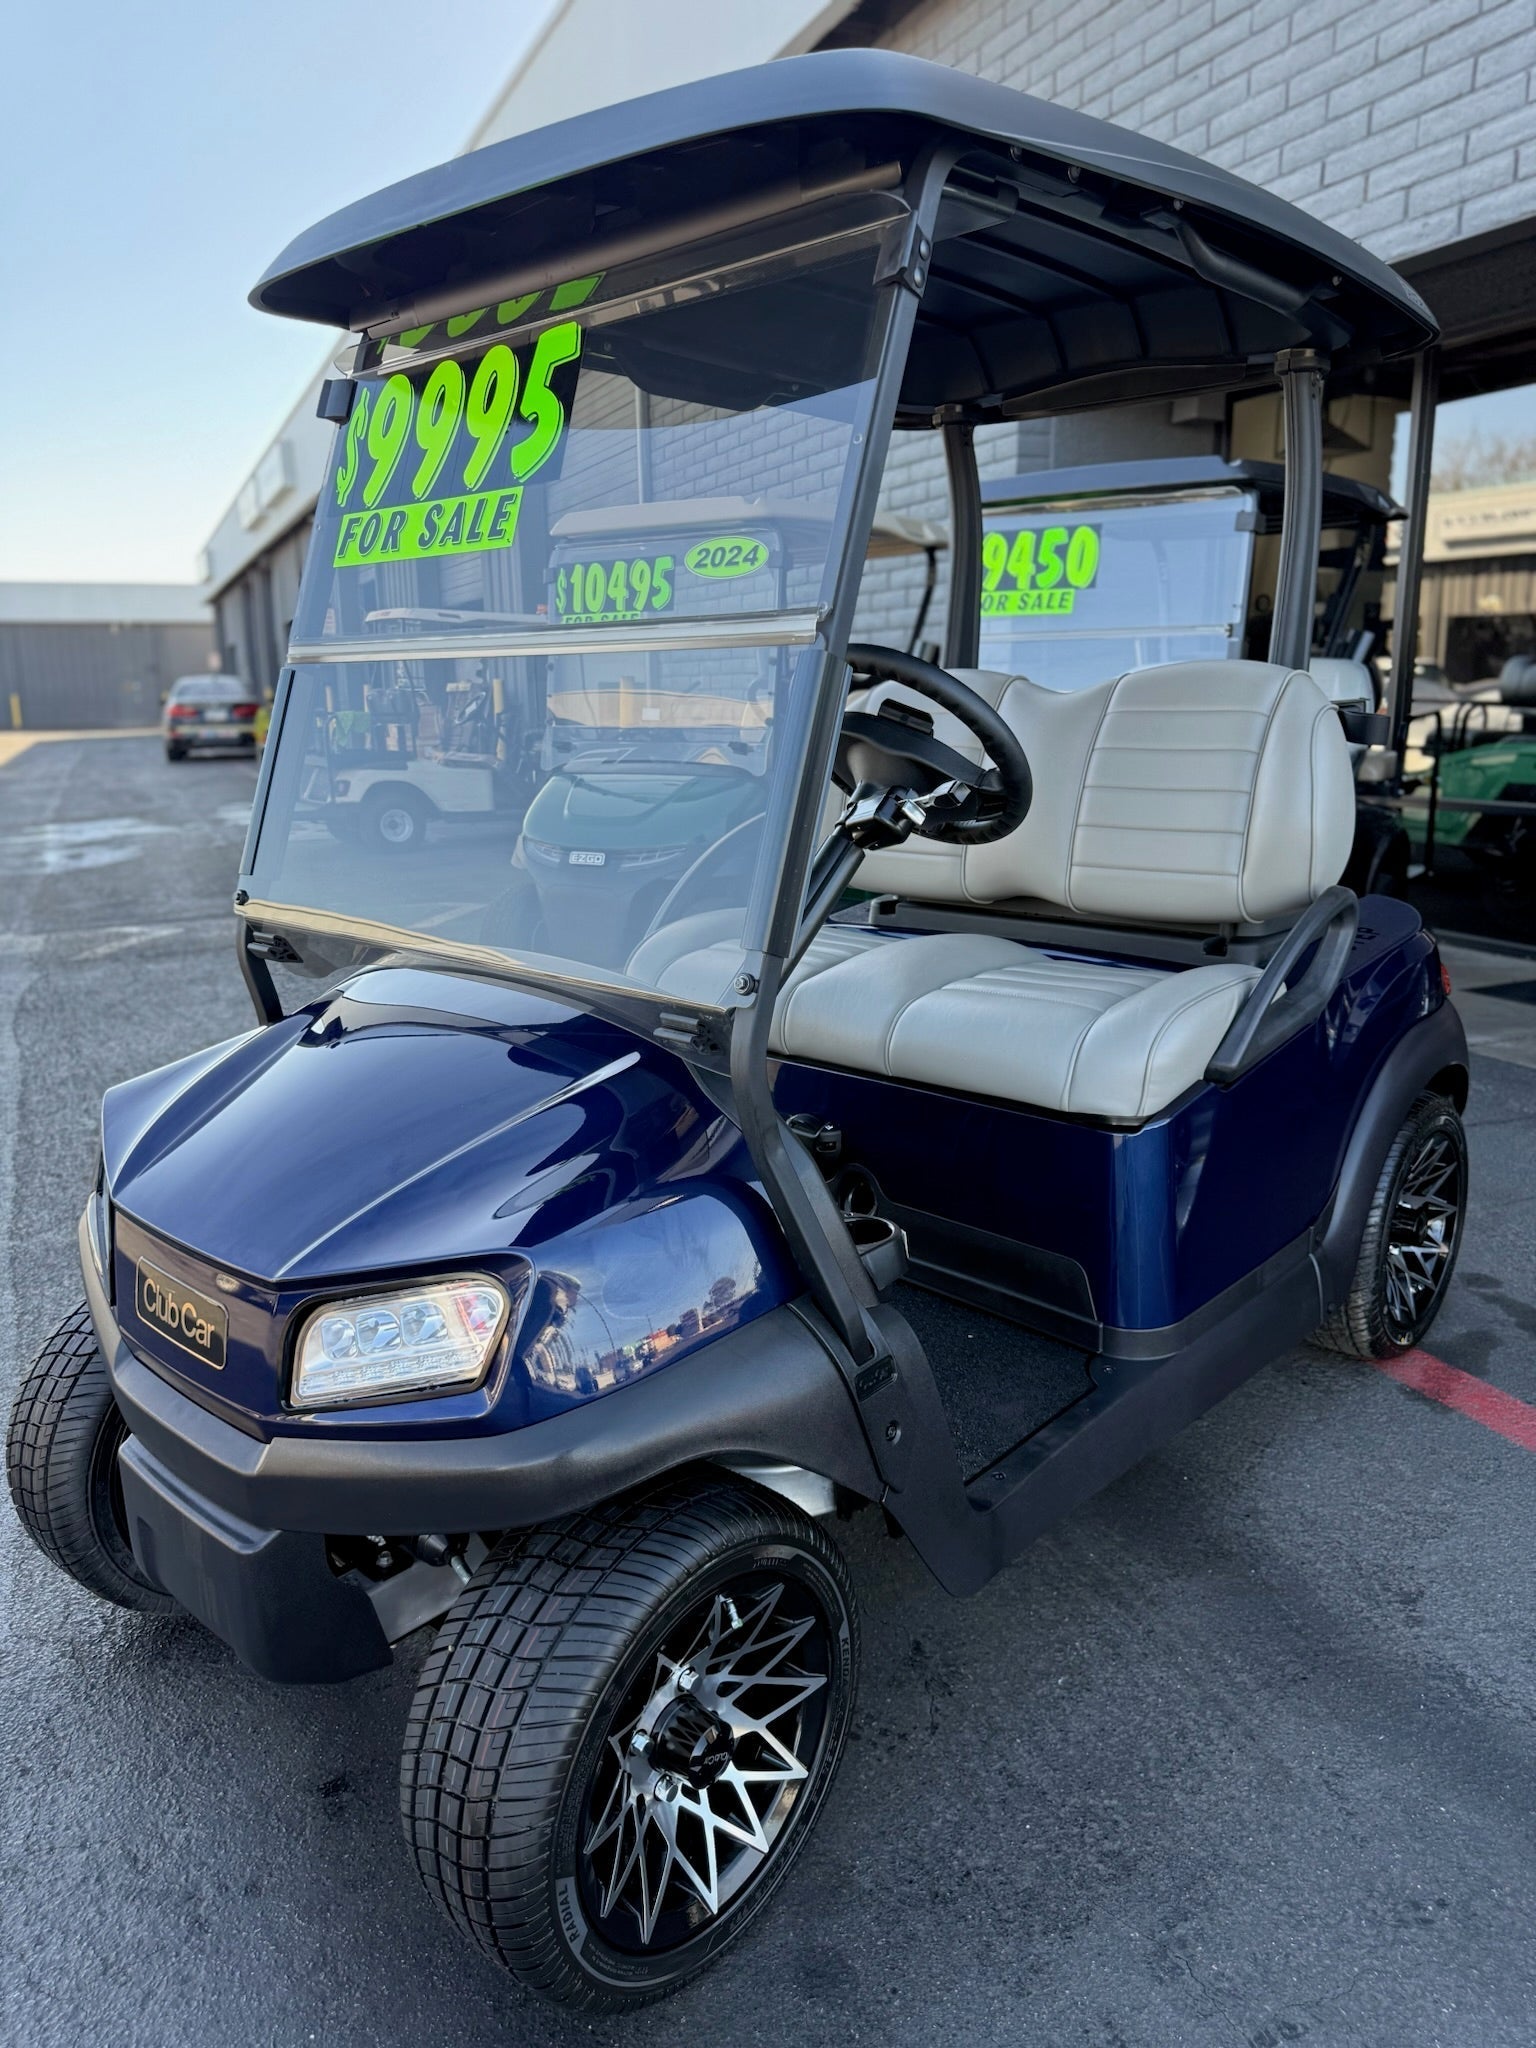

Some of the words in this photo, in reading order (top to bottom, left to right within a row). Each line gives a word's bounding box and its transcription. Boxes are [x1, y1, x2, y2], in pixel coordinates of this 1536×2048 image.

[336, 320, 581, 509] $9995
[337, 510, 408, 558] FOR
[418, 493, 517, 549] SALE
[556, 556, 674, 614] $10495
[693, 545, 760, 568] 2024
[982, 525, 1099, 591] 9450
[982, 594, 1008, 611] OR
[1018, 591, 1072, 610] SALE
[559, 1883, 580, 1943] RADIAL
